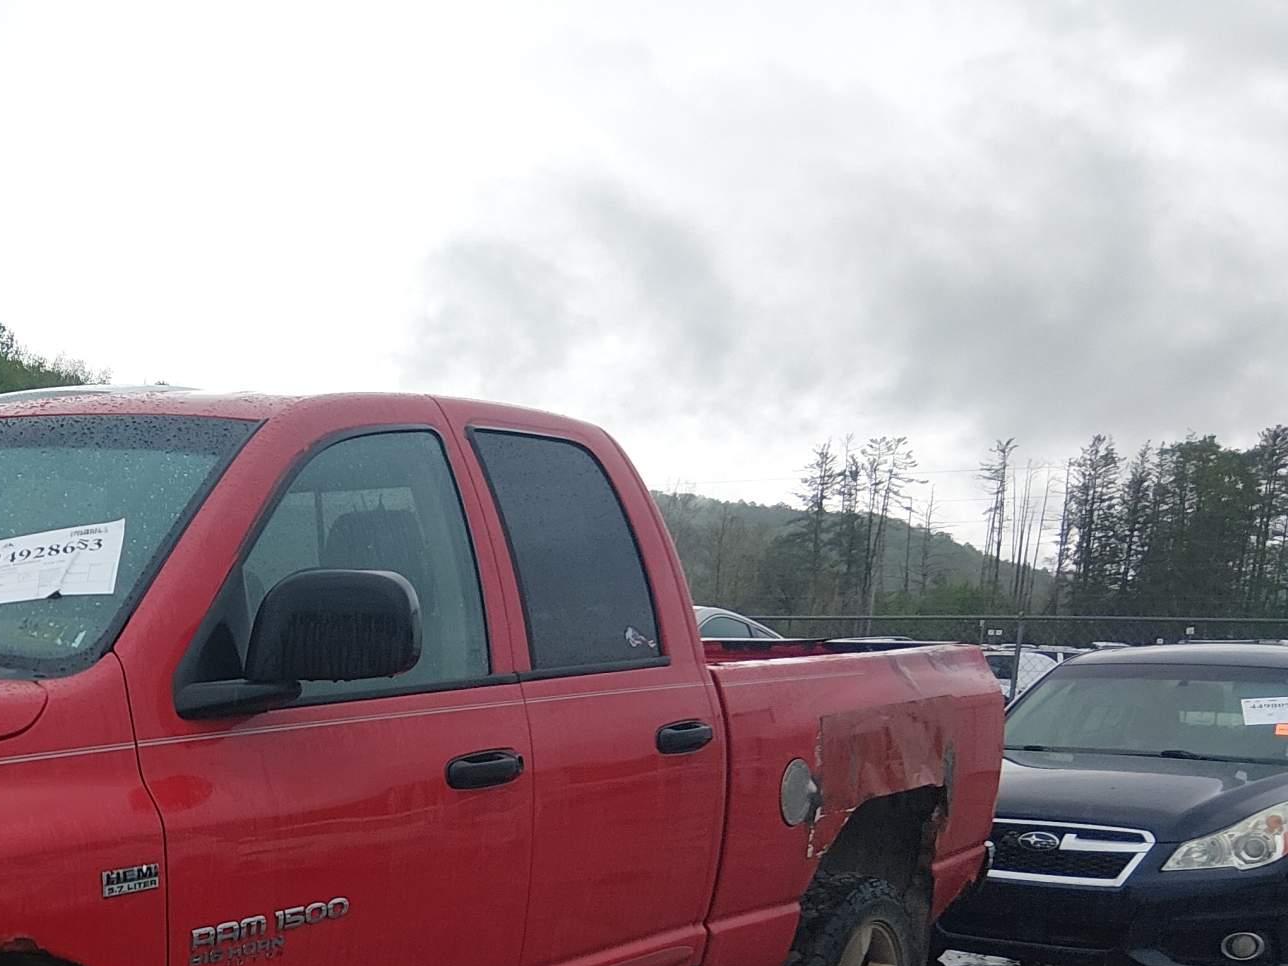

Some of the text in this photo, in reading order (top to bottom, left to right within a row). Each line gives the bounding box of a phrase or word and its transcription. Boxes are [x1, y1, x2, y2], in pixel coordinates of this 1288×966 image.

[127, 879, 157, 891] LITER
[192, 897, 350, 949] RAM 1500
[228, 935, 285, 958] HORN
